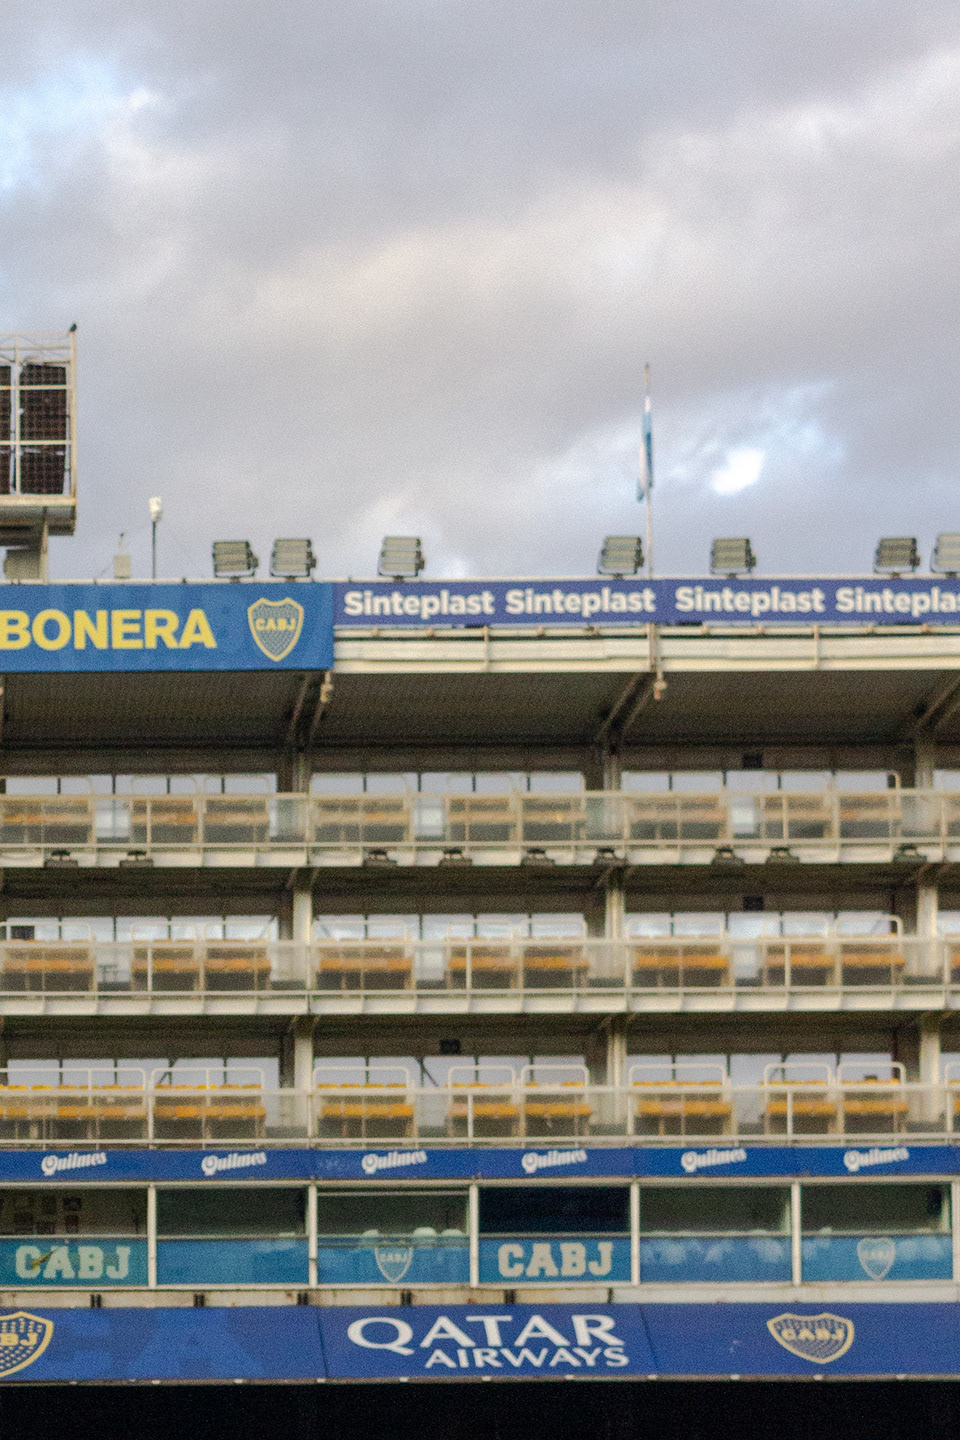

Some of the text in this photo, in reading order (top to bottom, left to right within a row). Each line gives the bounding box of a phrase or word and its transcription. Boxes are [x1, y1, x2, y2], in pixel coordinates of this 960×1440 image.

[344, 588, 656, 620] Sinteplast Sinteplast
[675, 586, 960, 617] Sinteplast Sintepla
[255, 618, 296, 631] CABJ
[41, 1152, 107, 1177] Quilmes
[201, 1151, 267, 1176] Quilmes
[361, 1150, 427, 1174] Quilmes
[15, 1245, 131, 1279] CABJ
[498, 1241, 614, 1277] CABJ
[347, 1314, 626, 1357] QATAR
[781, 1331, 844, 1341] CABJ
[425, 1347, 629, 1368] AIRWAYS
